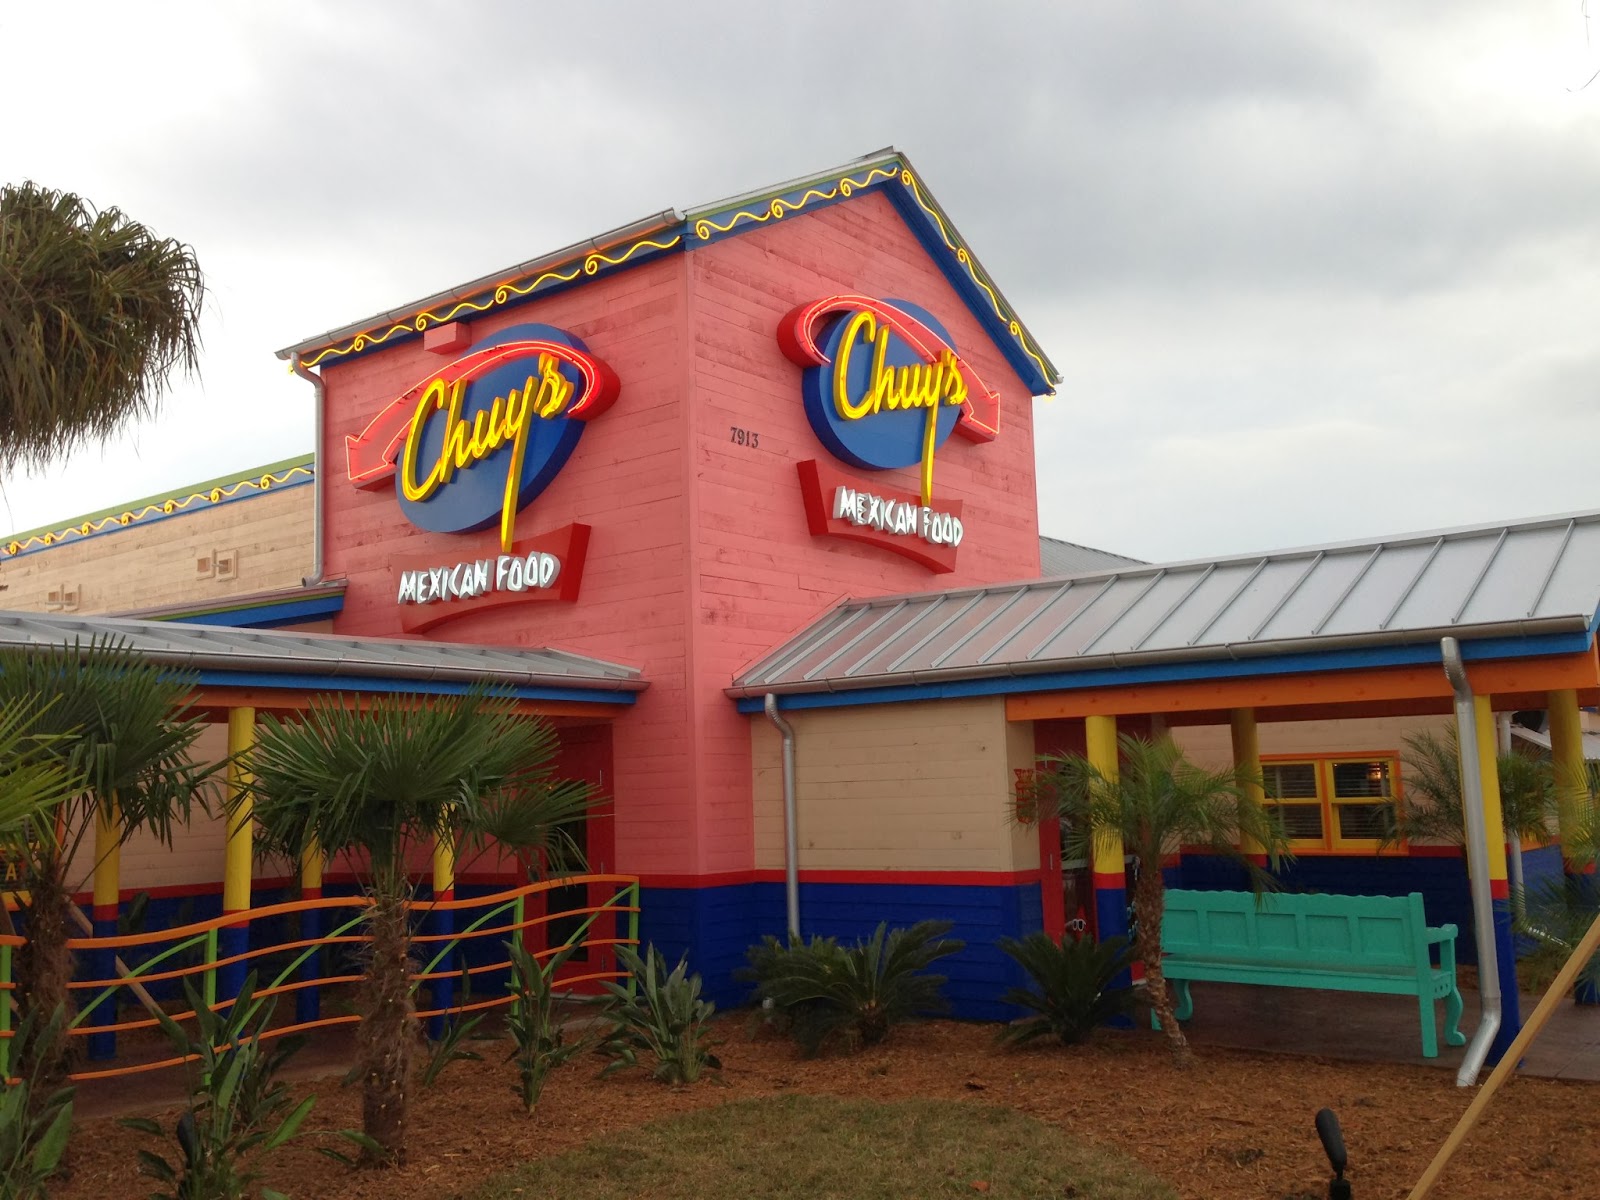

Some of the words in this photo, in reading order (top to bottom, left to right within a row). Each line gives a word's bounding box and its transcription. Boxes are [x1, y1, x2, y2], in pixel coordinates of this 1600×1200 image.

[730, 426, 759, 449] 7913
[833, 310, 968, 506] Chuy's
[402, 352, 574, 552] Chuy's
[833, 486, 918, 535] MEXICAN
[918, 507, 964, 547] FOOD
[397, 558, 496, 604] MEXICAN
[496, 551, 561, 591] FOOD
